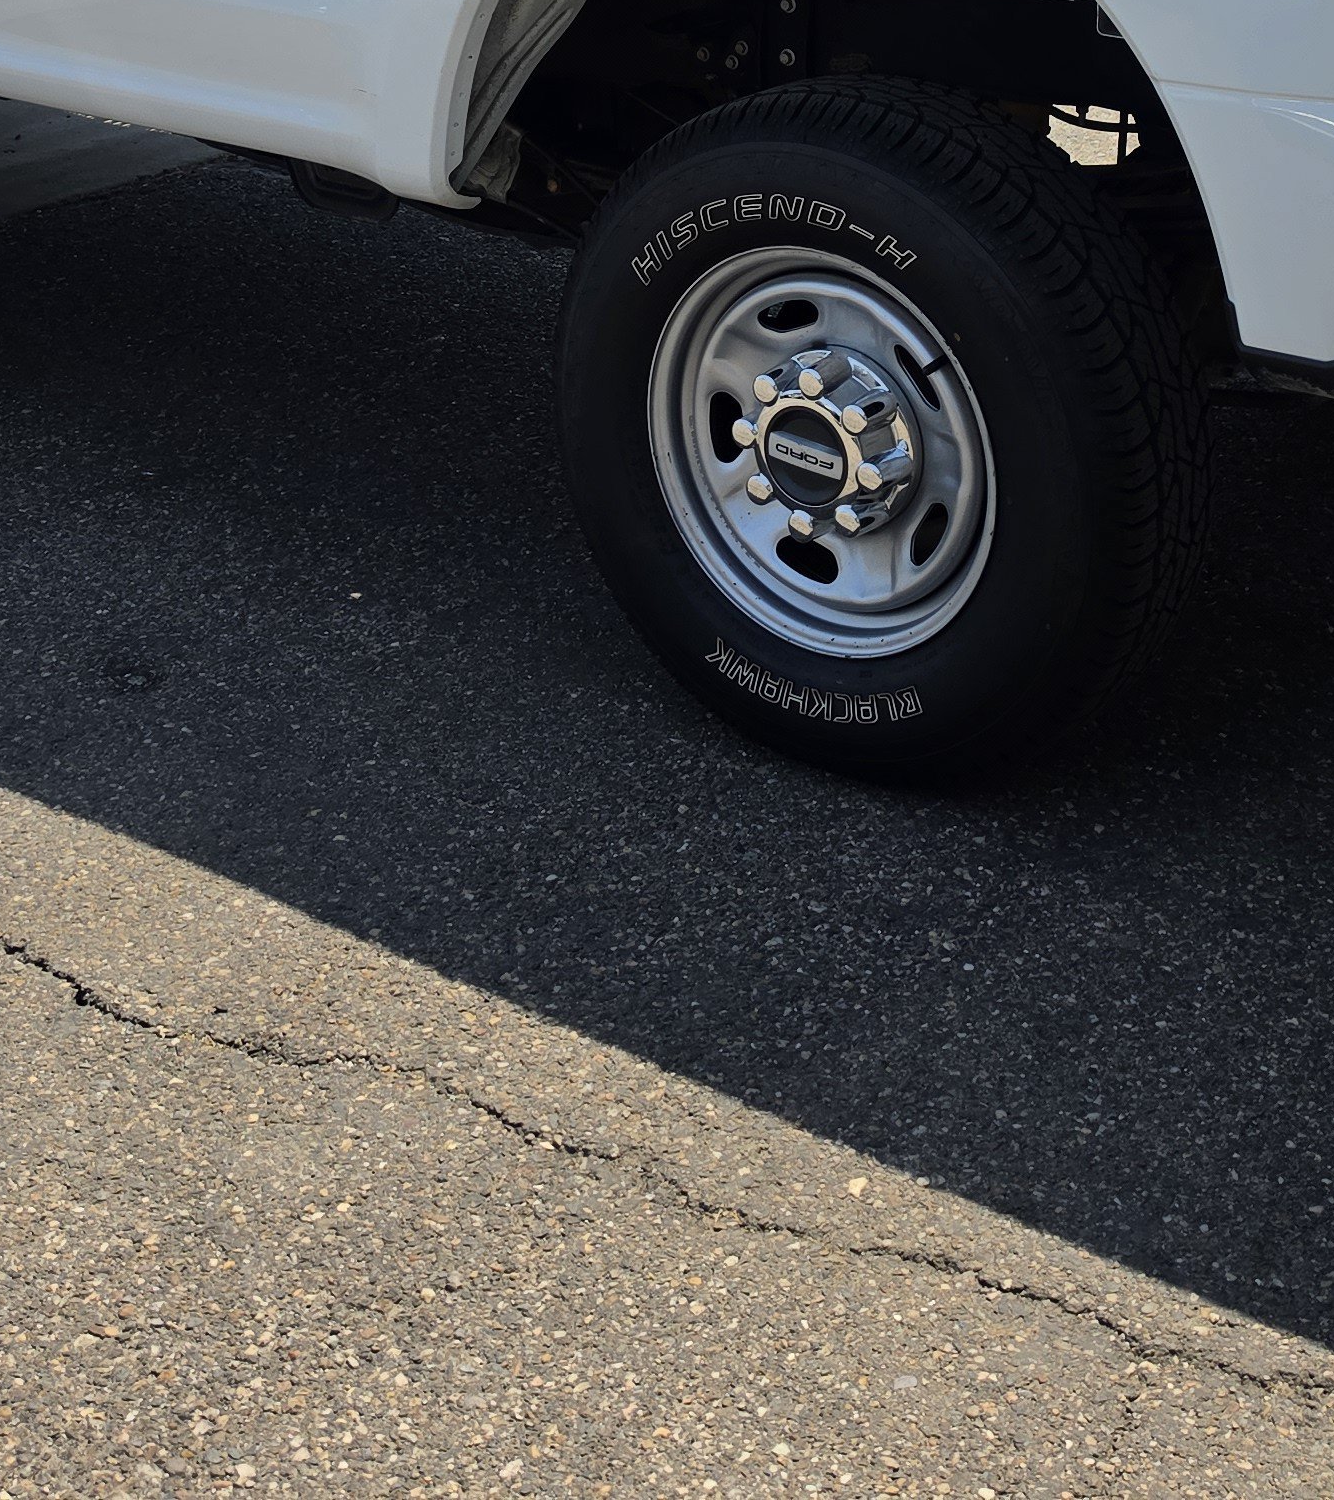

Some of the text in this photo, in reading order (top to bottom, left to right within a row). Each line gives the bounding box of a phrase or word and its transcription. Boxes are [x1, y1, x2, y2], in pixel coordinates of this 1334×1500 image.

[631, 193, 917, 287] HISCEND-H
[775, 443, 835, 470] FORD
[705, 636, 923, 725] BLACKHAWK
